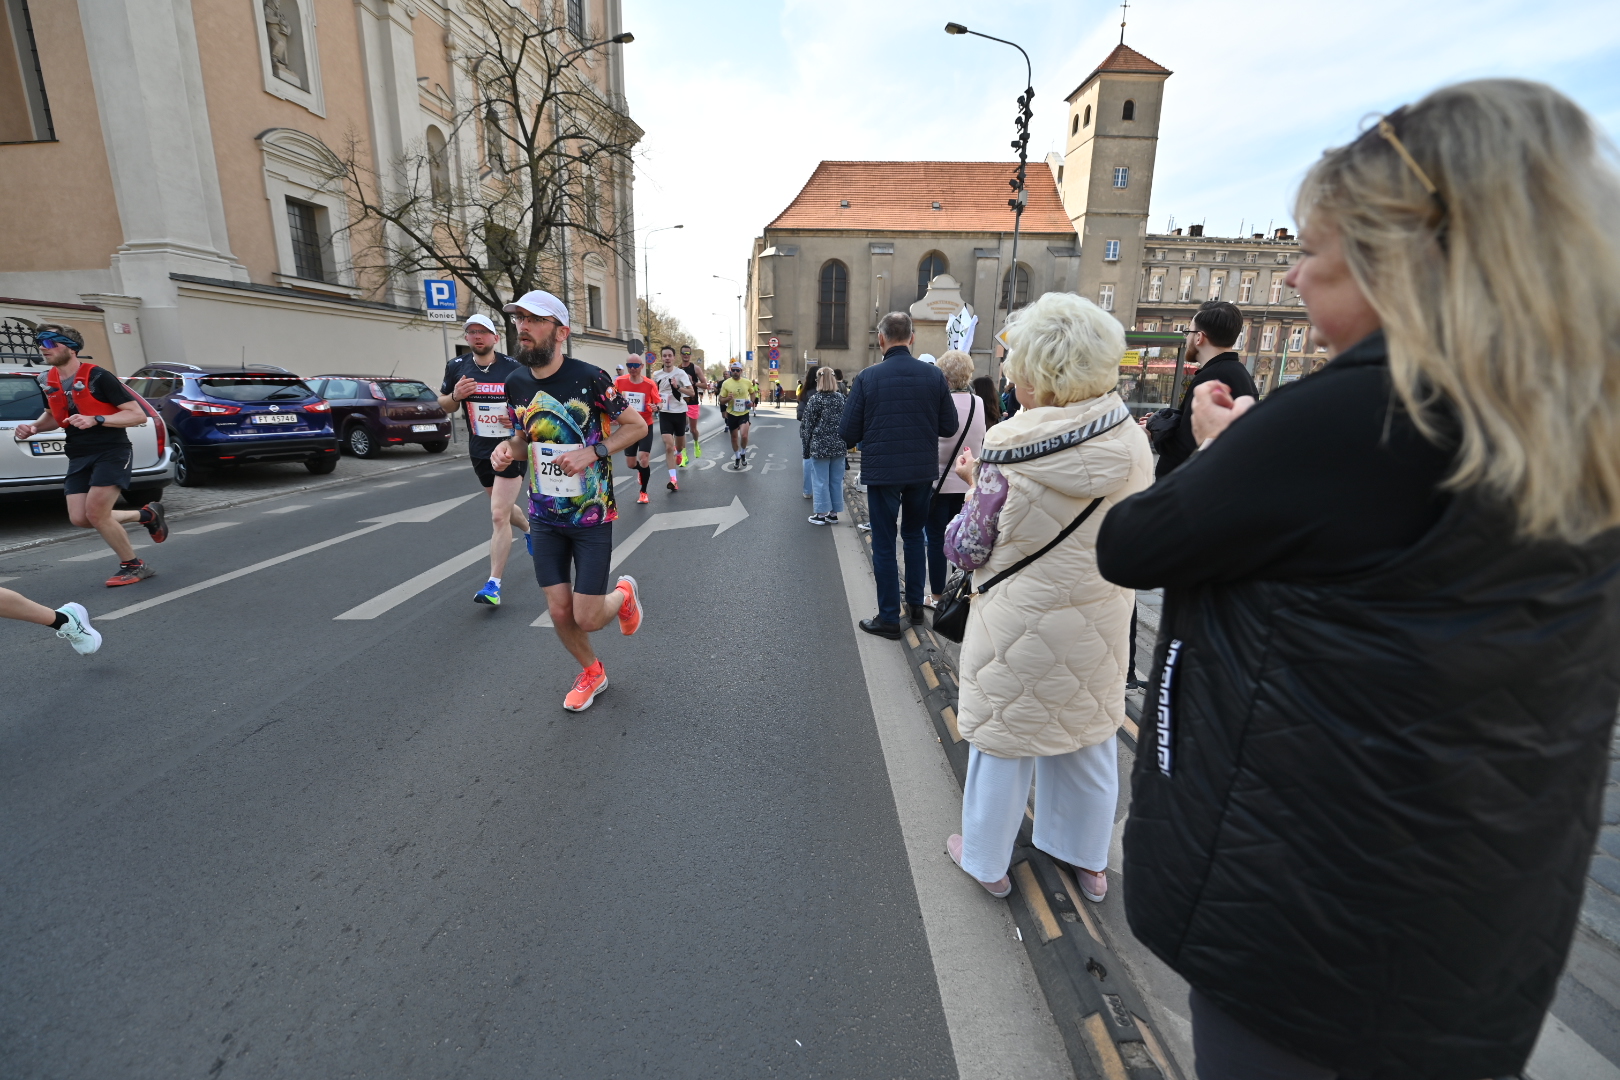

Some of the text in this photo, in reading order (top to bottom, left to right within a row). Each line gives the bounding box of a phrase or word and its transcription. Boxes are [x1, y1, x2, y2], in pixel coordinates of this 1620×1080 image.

[431, 282, 450, 306] P
[429, 311, 455, 319] Koniec
[474, 384, 505, 393] EGUN
[477, 414, 504, 424] 420
[1010, 429, 1081, 459] FASHION
[541, 461, 568, 476] 278
